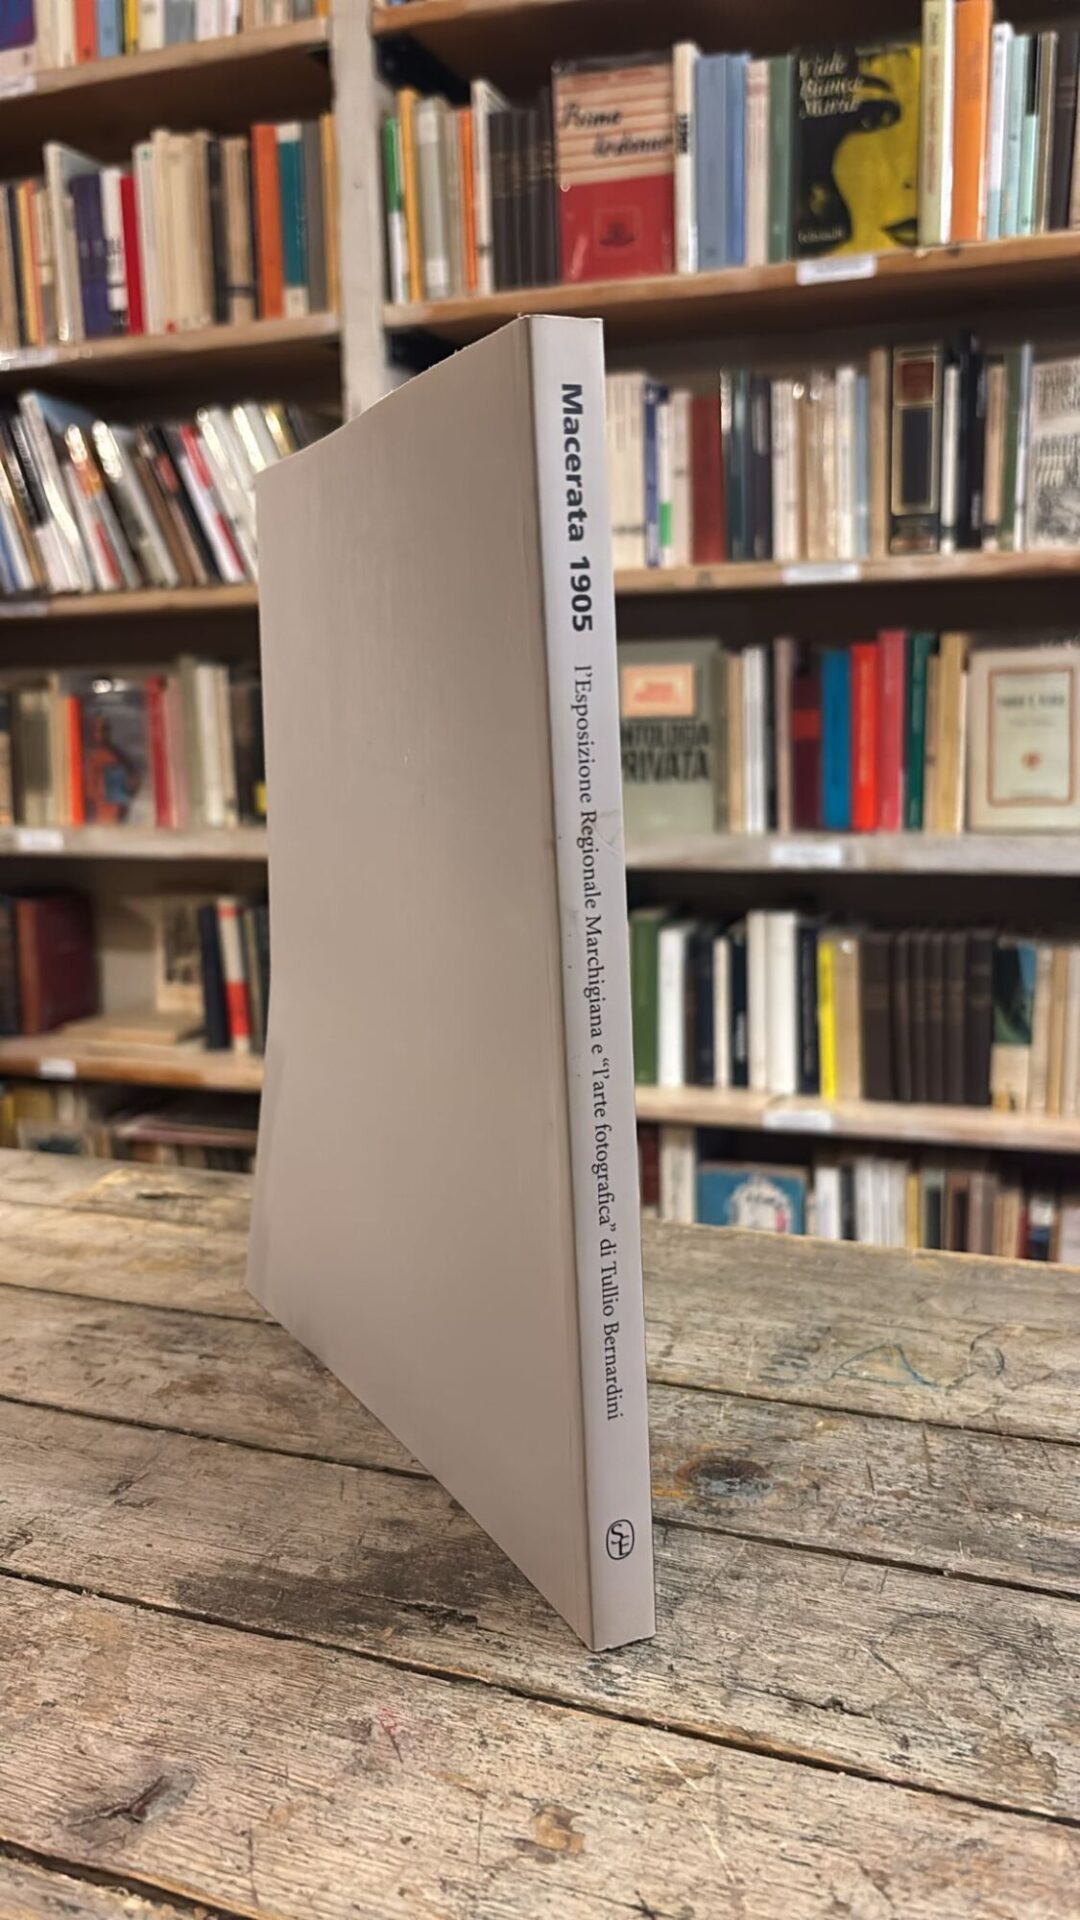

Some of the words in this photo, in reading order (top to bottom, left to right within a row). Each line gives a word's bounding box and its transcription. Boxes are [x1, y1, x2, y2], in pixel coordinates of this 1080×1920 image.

[562, 384, 588, 541] Macerata
[570, 556, 593, 632] 1905
[571, 666, 596, 803] l’Esposizione
[621, 749, 709, 783] RIVATA
[577, 810, 602, 908] Regionale
[584, 915, 606, 1038] Marchigiana
[591, 1044, 603, 1055] e
[592, 1058, 610, 1118] “l’arte
[591, 1123, 617, 1232] fotografica”
[600, 1238, 617, 1258] di
[601, 1261, 619, 1317] Tullio
[604, 1322, 624, 1420] Bernardini
